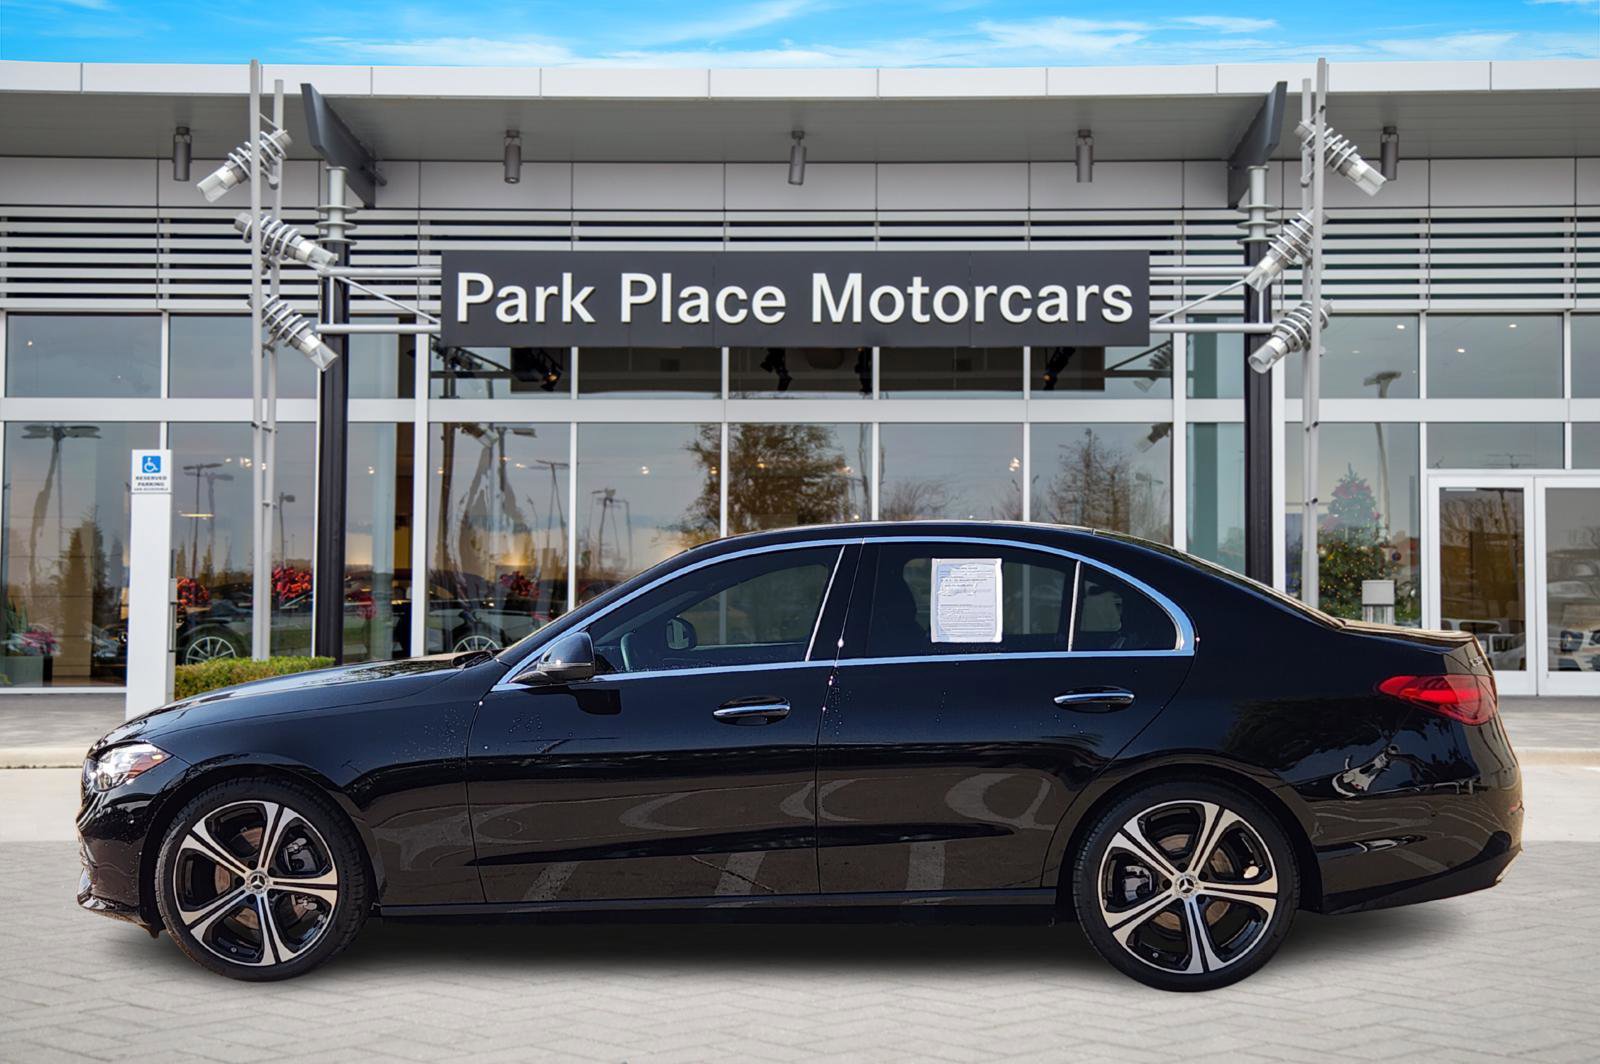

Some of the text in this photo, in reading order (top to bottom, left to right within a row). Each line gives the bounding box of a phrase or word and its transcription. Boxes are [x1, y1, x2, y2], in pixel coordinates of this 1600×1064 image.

[457, 272, 1133, 323] Park Place Motorcars
